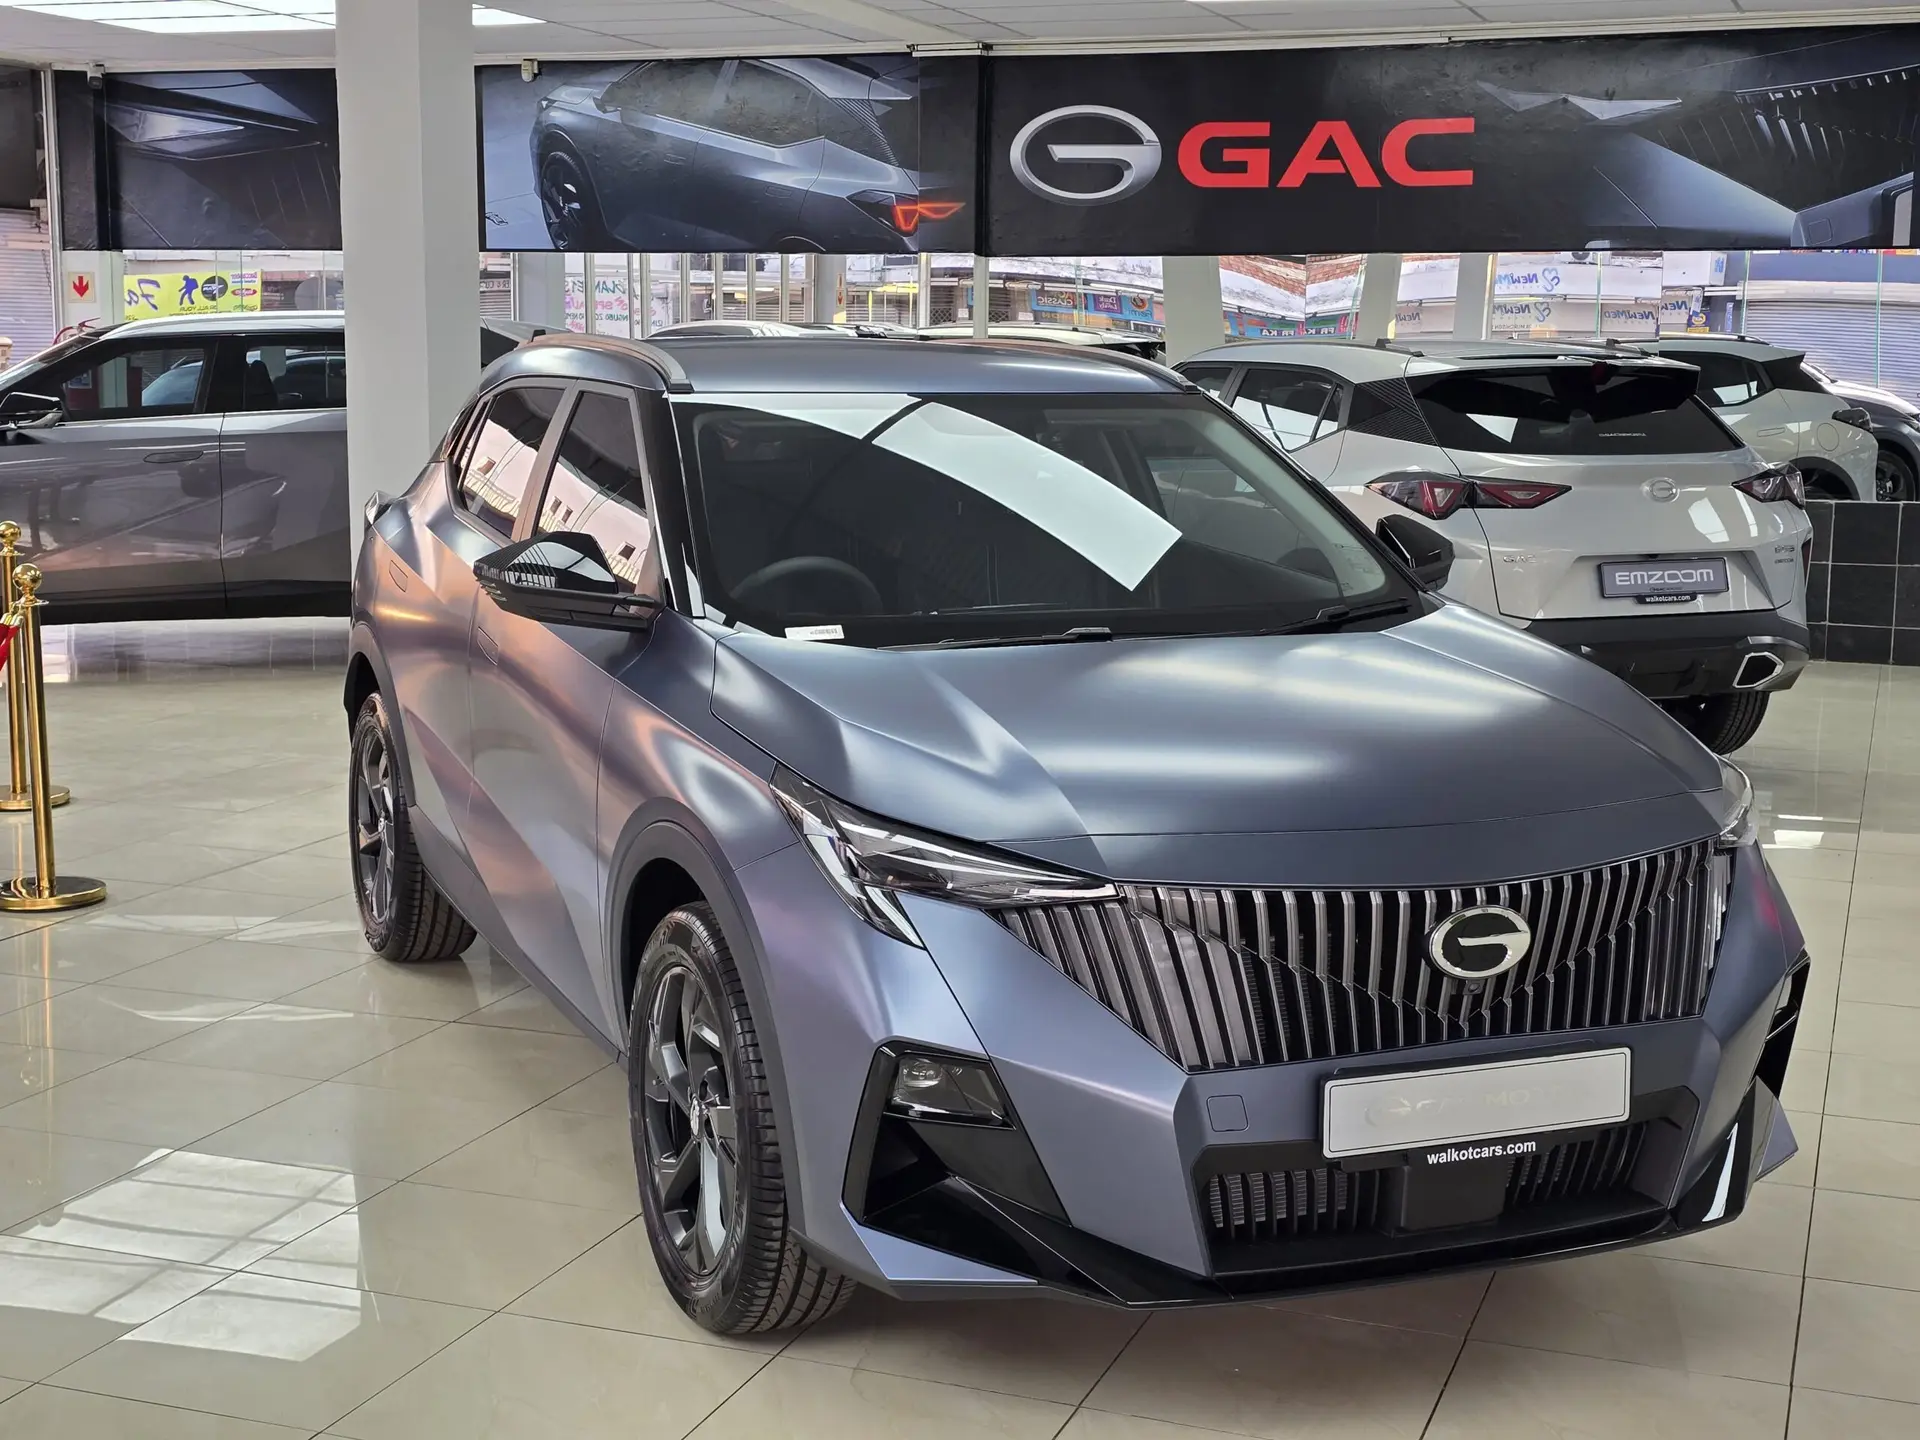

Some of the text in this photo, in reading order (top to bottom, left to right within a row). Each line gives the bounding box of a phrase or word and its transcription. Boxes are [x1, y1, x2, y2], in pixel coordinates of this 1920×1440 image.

[1177, 117, 1475, 188] GAC
[1615, 568, 1714, 585] EMZOOM
[1645, 594, 1691, 602] walkotcars.com
[1426, 1139, 1537, 1165] walkotcars.com
